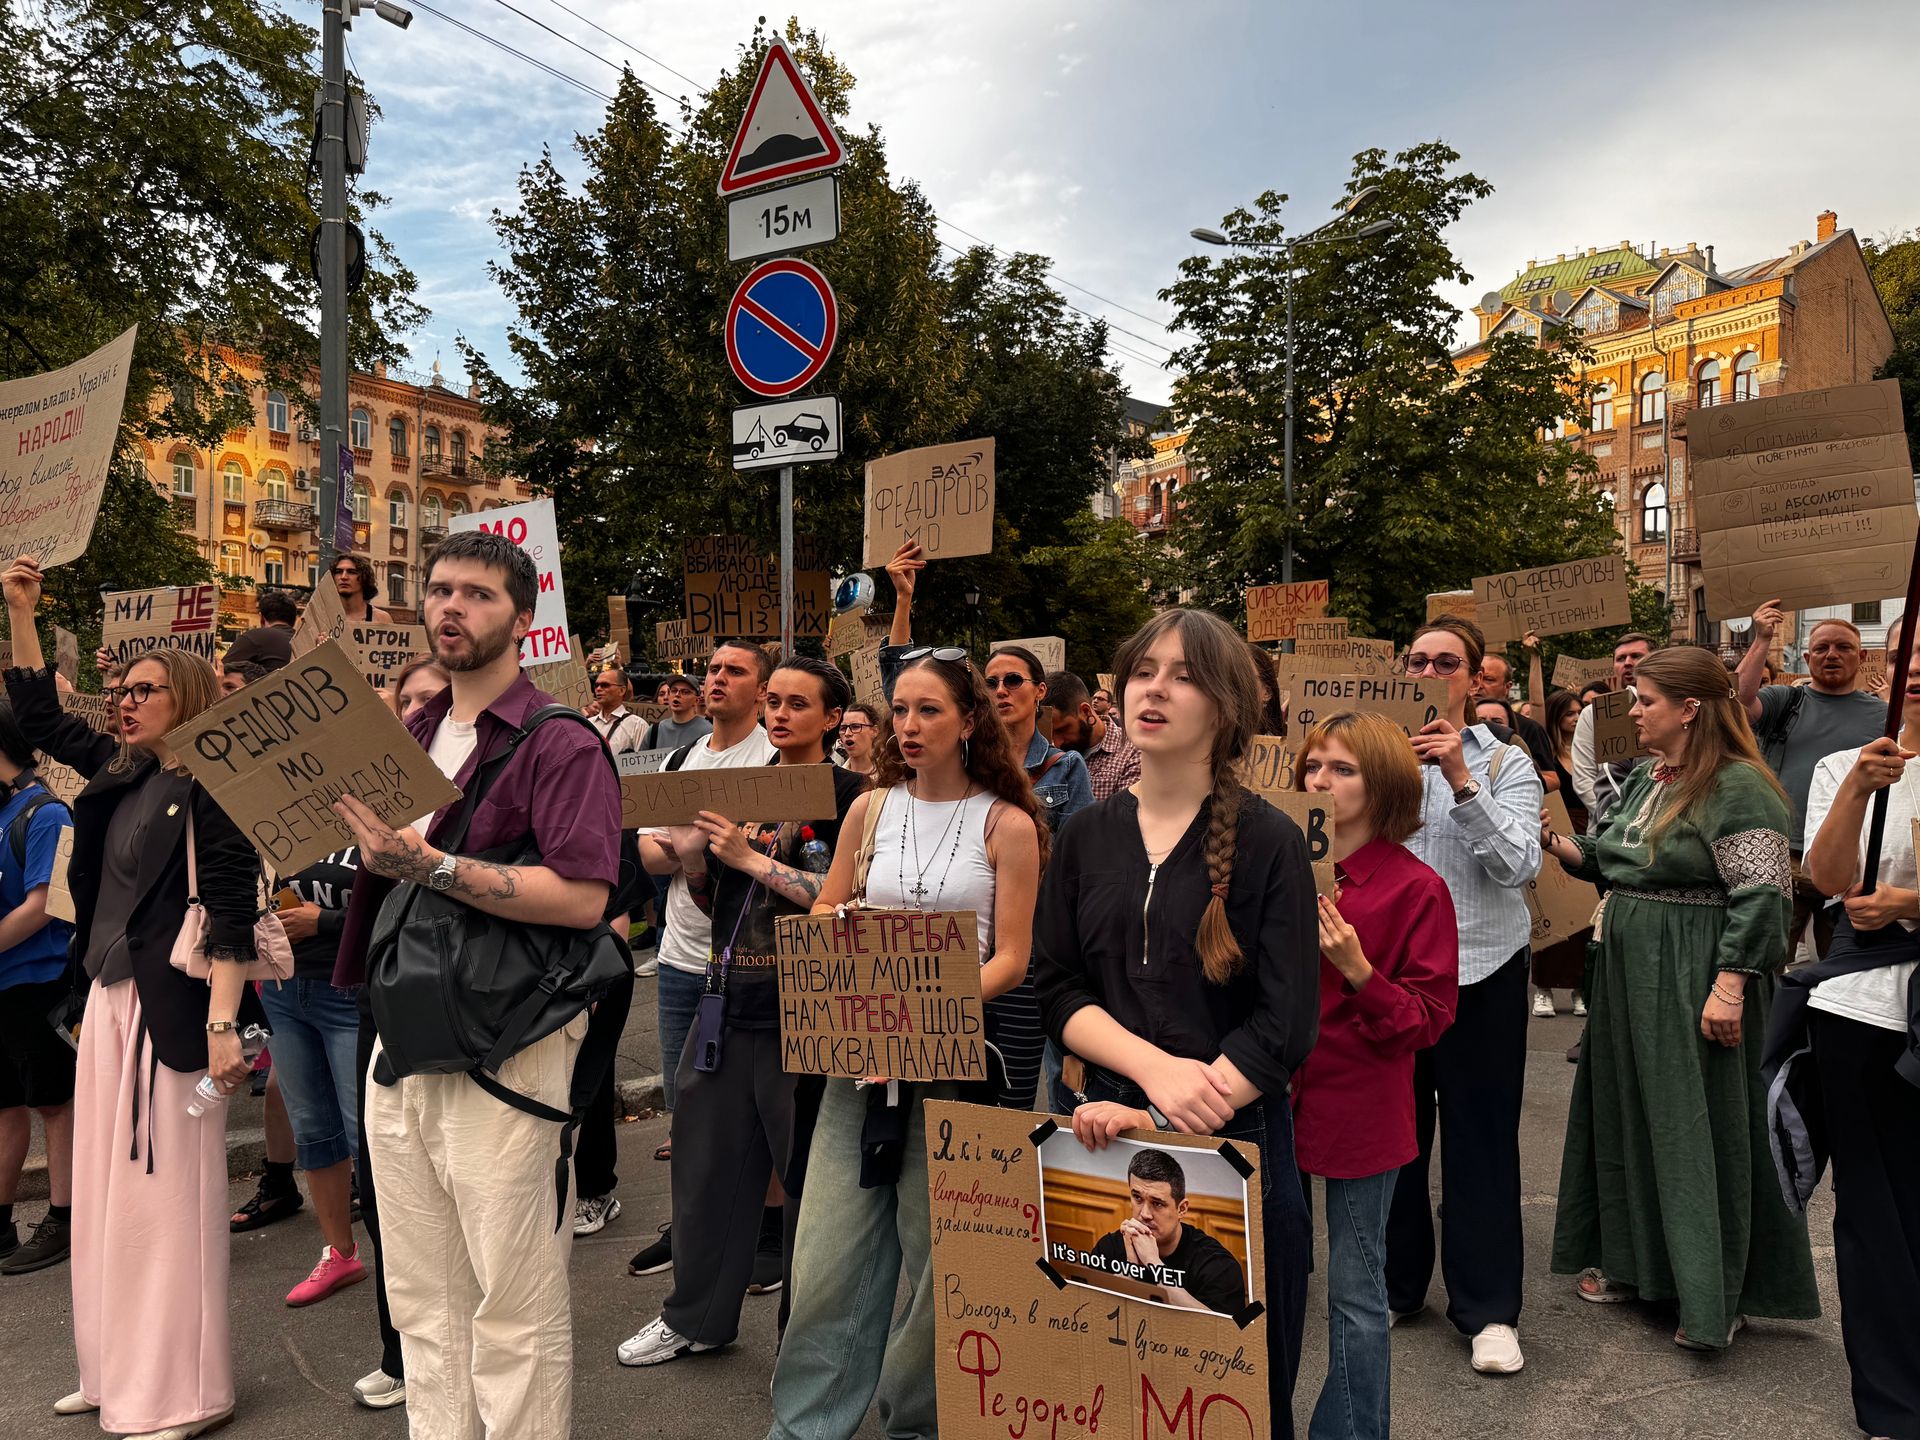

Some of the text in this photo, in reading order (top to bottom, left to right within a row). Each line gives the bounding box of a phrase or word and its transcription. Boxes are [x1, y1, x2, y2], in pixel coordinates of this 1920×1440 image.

[42, 389, 70, 411] влади
[77, 365, 111, 402] Україні
[1763, 391, 1832, 417] ChatGPT
[18, 404, 86, 457] НАРОД!!!
[1755, 426, 1824, 450] ПИТАННЯ:
[1756, 444, 1819, 465] ПОВЕРНУТИ
[874, 473, 989, 531] ФЕДОРОВ
[1760, 485, 1872, 516] ВИ АБСОЛЮТНО
[1818, 503, 1865, 520] ПАНЕ
[903, 523, 940, 552] МО
[1247, 581, 1328, 610] СИРСЬКИЙ
[1486, 559, 1615, 602] МО-ФЕДОРОВУ
[114, 585, 214, 622] МИ НЕ
[689, 593, 742, 635] ВІН
[1496, 596, 1551, 618] МІНВЕТ
[1527, 597, 1606, 632] ВЕТЕРАНУ!
[658, 636, 709, 659] ДОГОВОРИЛИ!
[664, 620, 684, 639] МИ
[1303, 678, 1425, 702] ПОВЕРНІТЬ
[194, 665, 349, 773] ФЕДОРОВ
[1601, 735, 1628, 757] ХТО
[276, 752, 324, 791] МО
[351, 753, 410, 802] ДЛЯ
[779, 913, 966, 955] НАМ НЕ ТРЕБА
[781, 954, 942, 993] НОВИЙ МО!!!
[783, 993, 980, 1039] НАМ ТРЕБА ЩОБ
[784, 1035, 985, 1079] МОСКВА ПАЛАЛА
[990, 1147, 1023, 1174] ще
[933, 1170, 1020, 1218] виправдання
[1052, 1243, 1187, 1287] It's not over YET
[944, 1273, 1017, 1330] Володя,
[1028, 1298, 1039, 1324] в
[1048, 1301, 1091, 1334] тебе
[1106, 1305, 1128, 1347] 1
[1134, 1318, 1169, 1361] вухо
[1174, 1345, 1190, 1359] не
[956, 1329, 1255, 1440] Федоров МО
